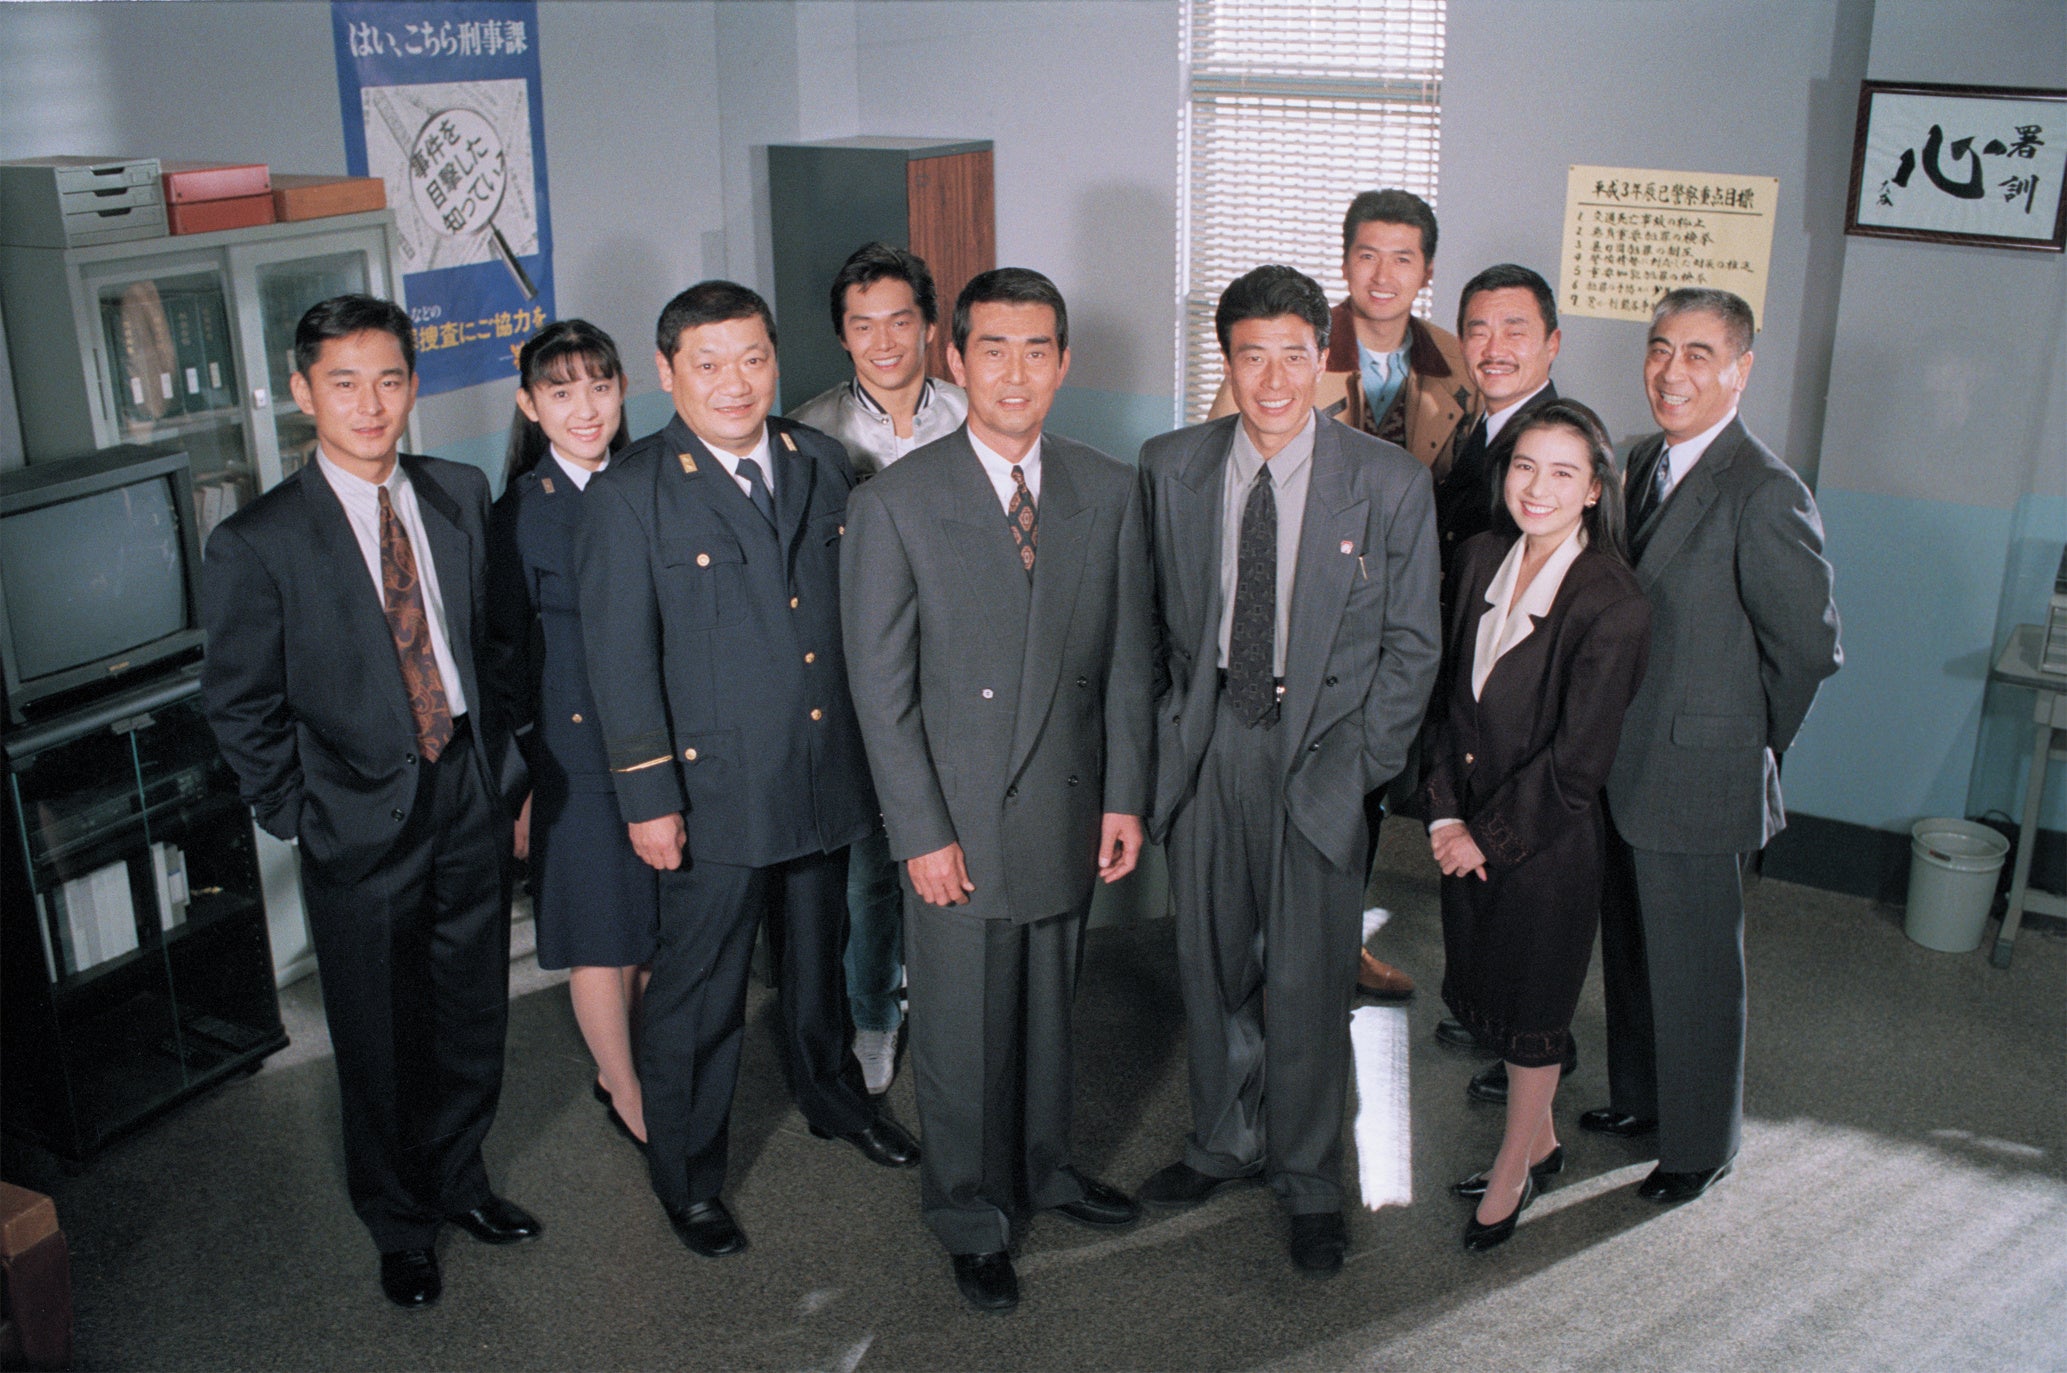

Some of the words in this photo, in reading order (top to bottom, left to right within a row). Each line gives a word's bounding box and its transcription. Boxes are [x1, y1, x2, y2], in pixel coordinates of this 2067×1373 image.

[348, 19, 529, 58] はい、こちら刑事課
[409, 118, 462, 179] 事件を
[425, 136, 489, 211] 目撃した
[1998, 124, 2046, 215] 署訓
[1571, 279, 1579, 291] 6
[1573, 265, 1582, 277] 5
